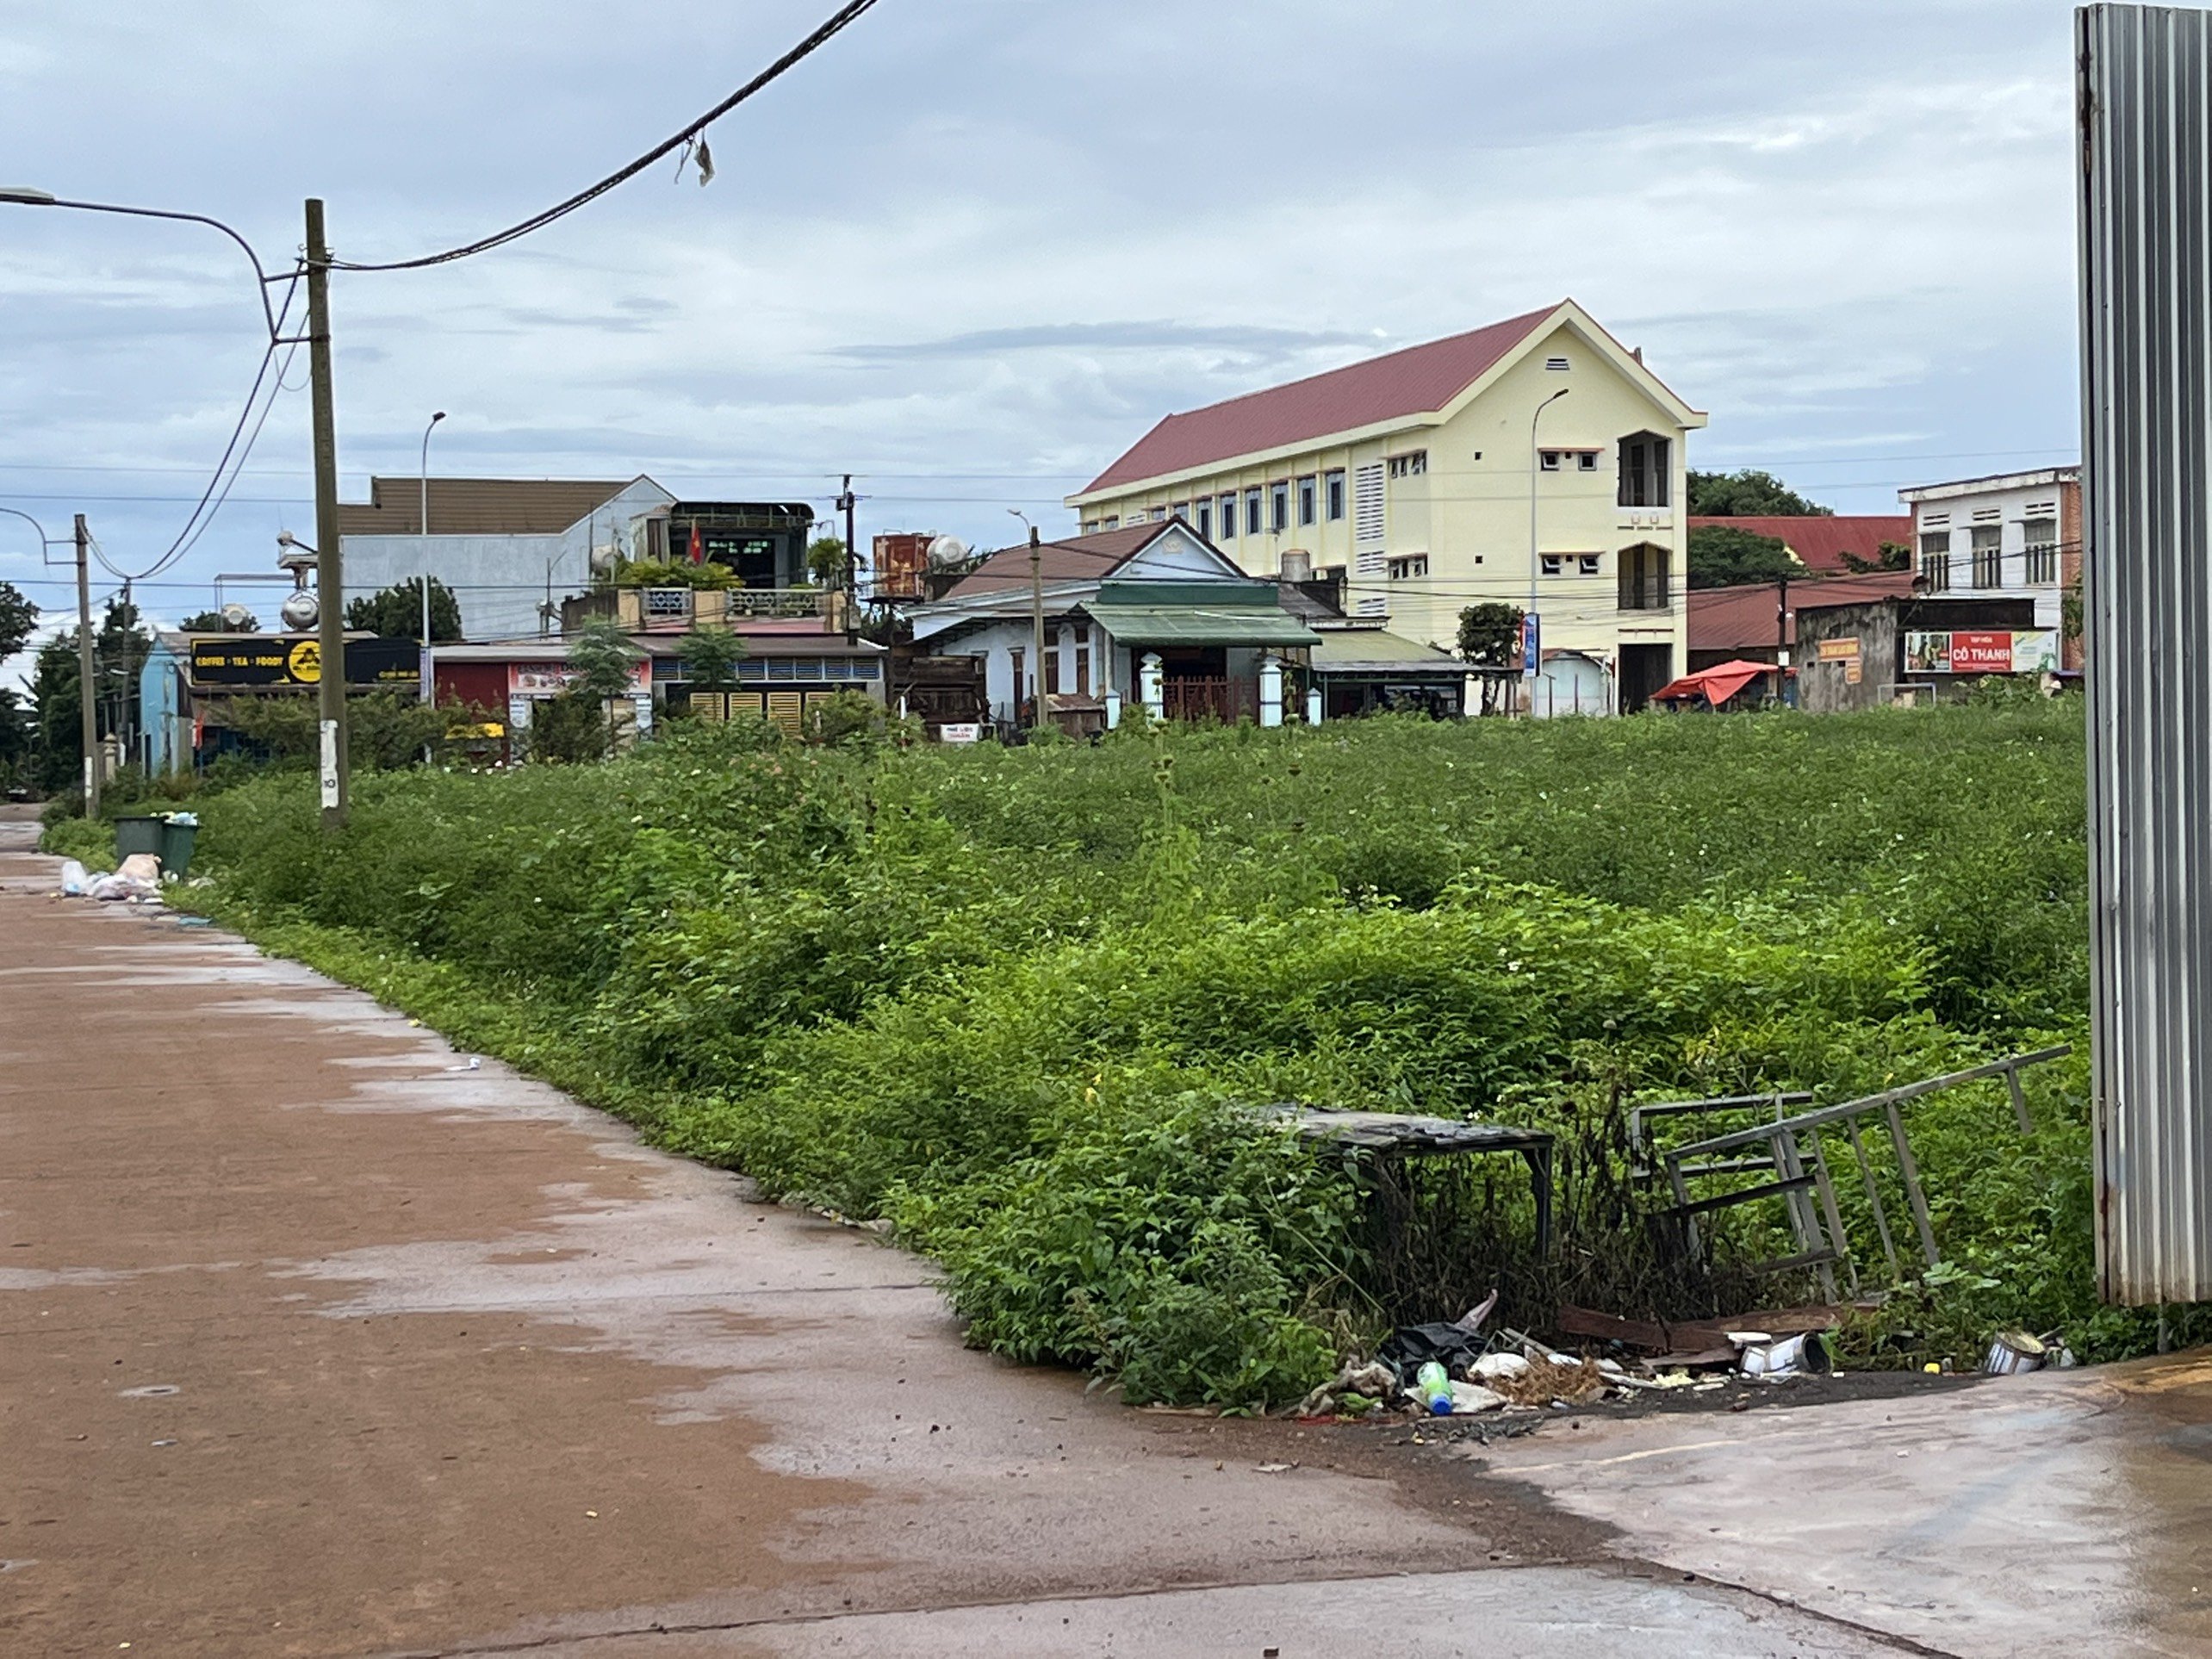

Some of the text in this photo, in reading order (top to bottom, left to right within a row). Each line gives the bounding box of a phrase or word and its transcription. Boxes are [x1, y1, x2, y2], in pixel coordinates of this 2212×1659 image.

[1953, 646, 1969, 662] CÔ
[1970, 648, 2010, 662] THANH
[233, 656, 248, 667] TEA
